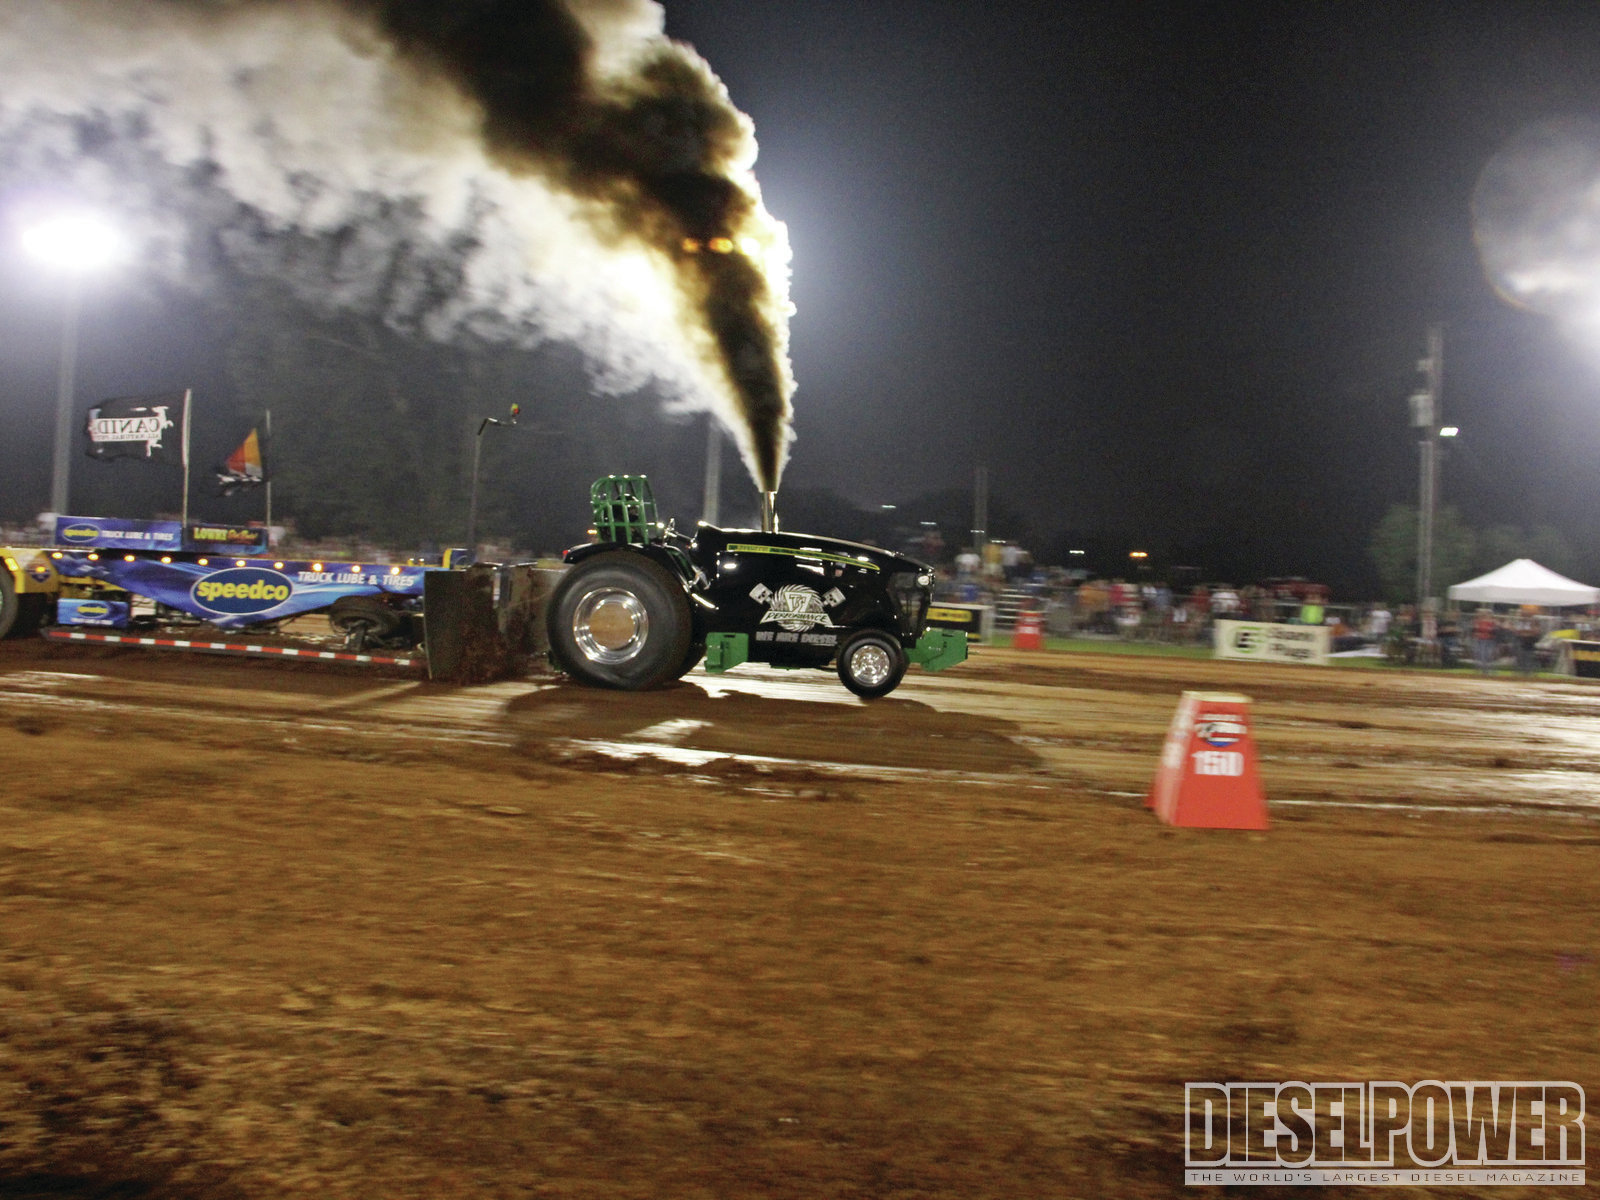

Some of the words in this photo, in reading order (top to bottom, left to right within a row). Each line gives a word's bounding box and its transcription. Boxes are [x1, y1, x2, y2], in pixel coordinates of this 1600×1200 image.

[298, 571, 333, 583] TRUCK
[336, 573, 367, 584] LUBE
[367, 575, 378, 585] &
[382, 574, 415, 587] TIRES
[196, 579, 289, 601] speedco
[765, 611, 828, 623] PERFORMANCE
